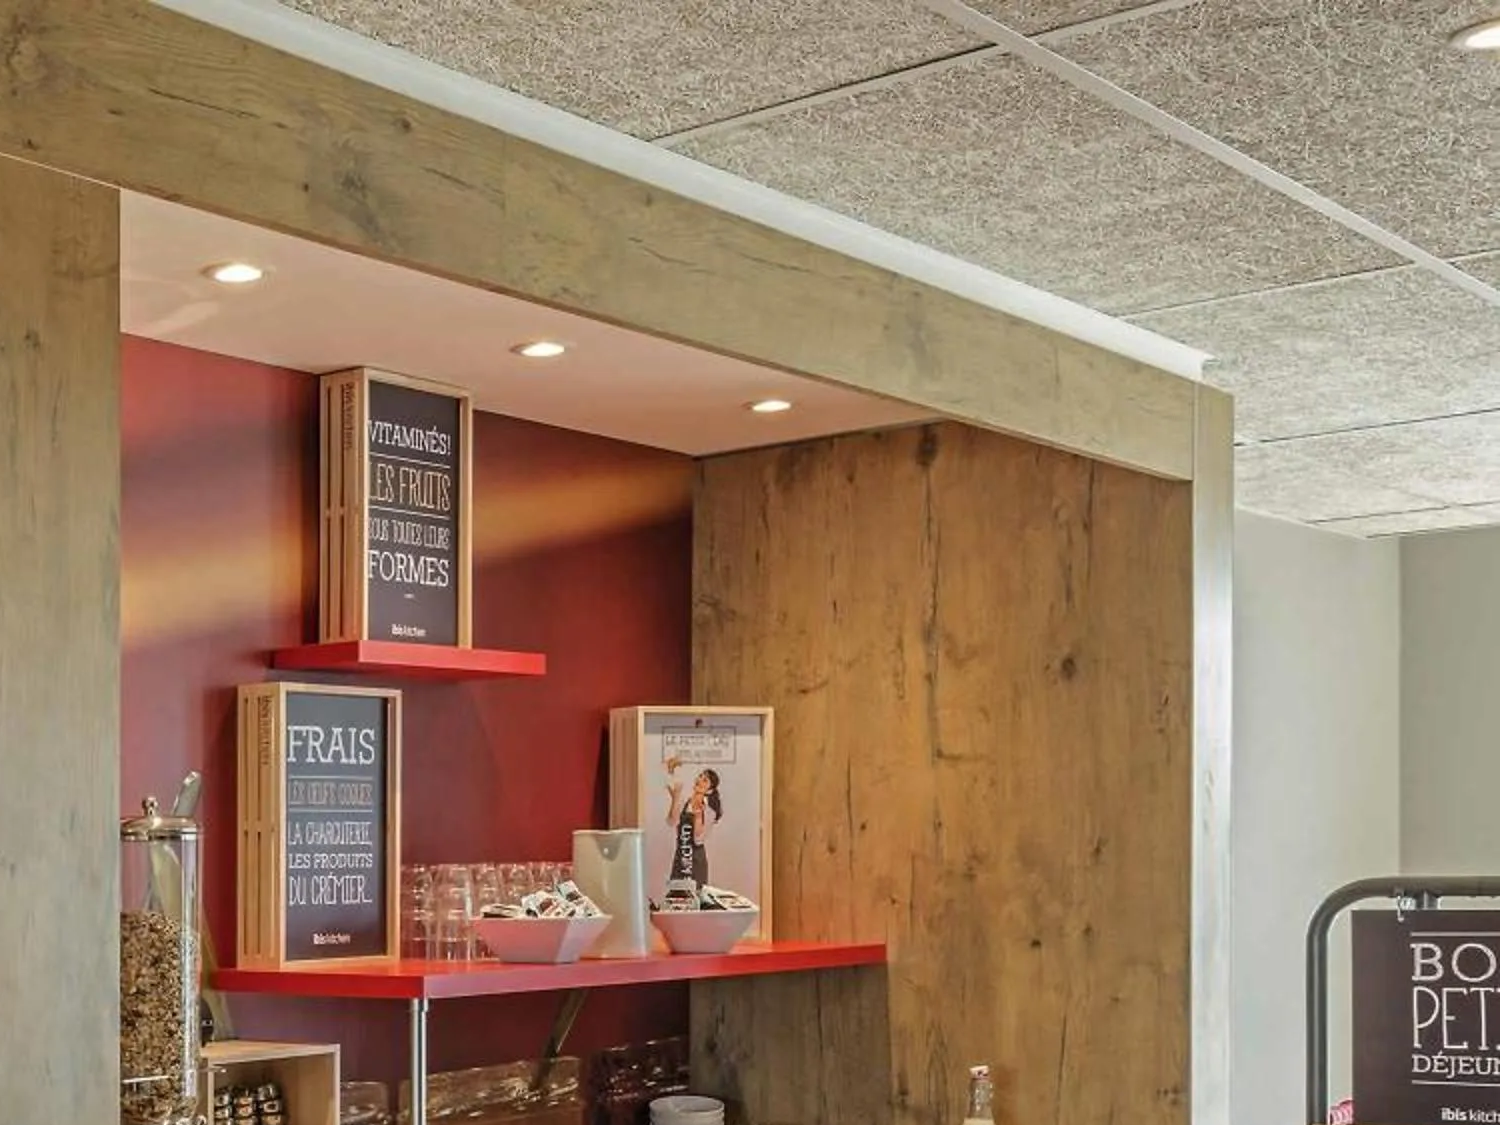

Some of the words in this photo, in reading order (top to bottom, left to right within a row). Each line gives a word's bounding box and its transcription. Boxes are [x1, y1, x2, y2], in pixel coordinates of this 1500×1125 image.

[399, 467, 451, 511] FRUITS
[368, 550, 450, 588] FORMES
[287, 725, 375, 765] FRAIS
[288, 853, 311, 869] LES
[313, 853, 373, 869] PRODUITS
[289, 875, 306, 906] DU
[1413, 985, 1500, 1050] PET
[1441, 1107, 1467, 1122] ibis
